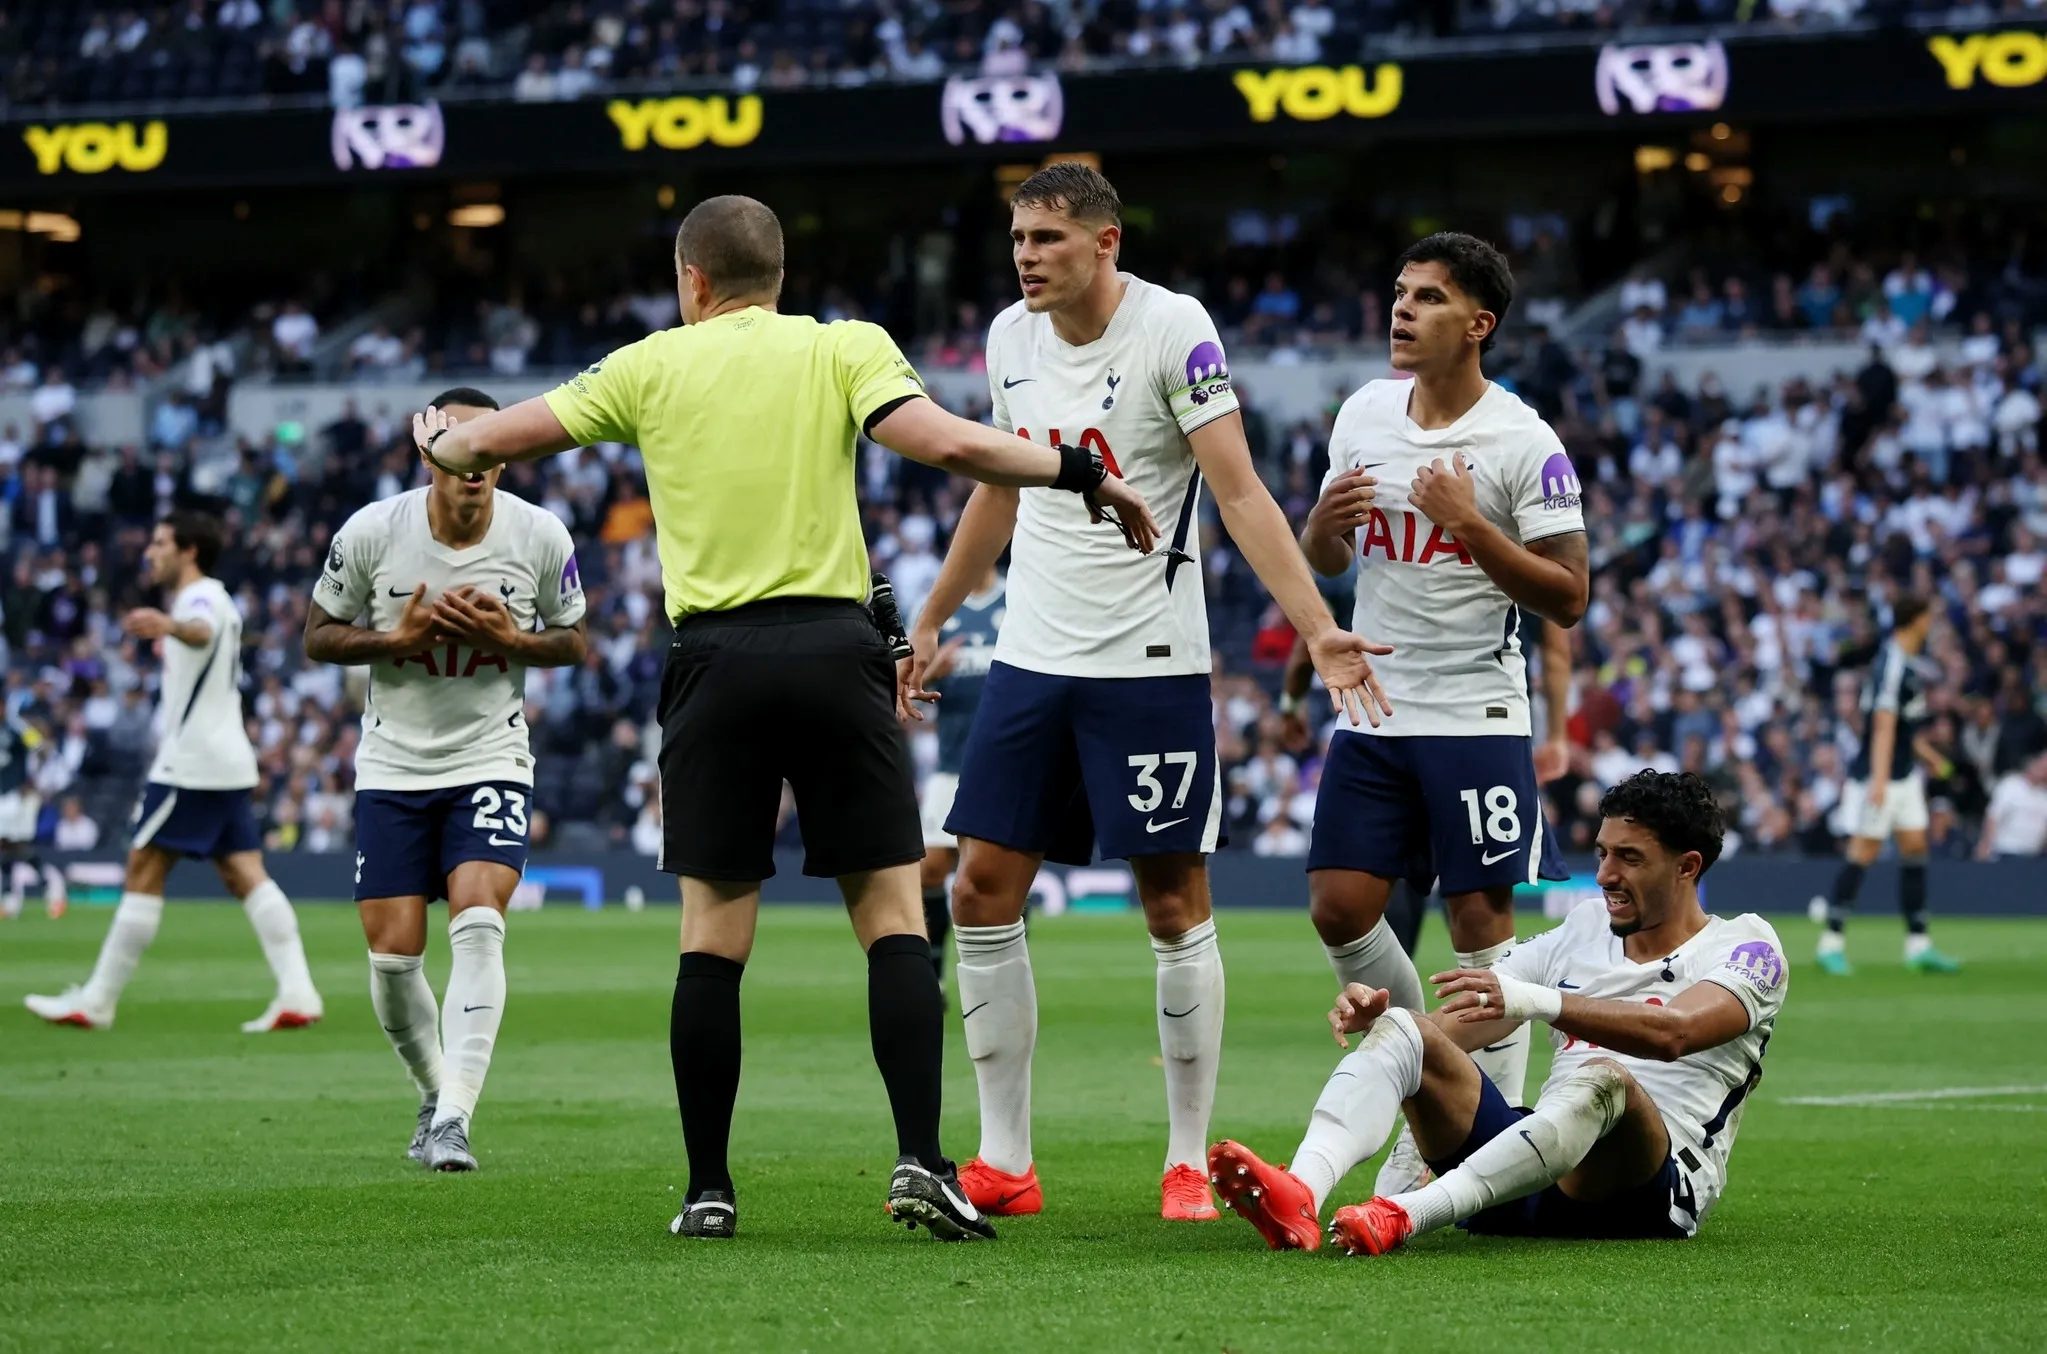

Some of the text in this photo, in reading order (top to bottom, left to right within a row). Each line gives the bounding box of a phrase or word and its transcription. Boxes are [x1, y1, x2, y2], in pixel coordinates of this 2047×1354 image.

[1929, 32, 2047, 89] YO
[1233, 63, 1402, 121] YOU
[24, 121, 167, 174] YOU
[607, 95, 762, 150] YOU
[1362, 507, 1473, 565] AIA
[1127, 751, 1198, 813] 37
[471, 786, 528, 837] 23
[1459, 785, 1521, 845] 18
[1724, 961, 1771, 998] kraken
[703, 1214, 725, 1226] NIKE
